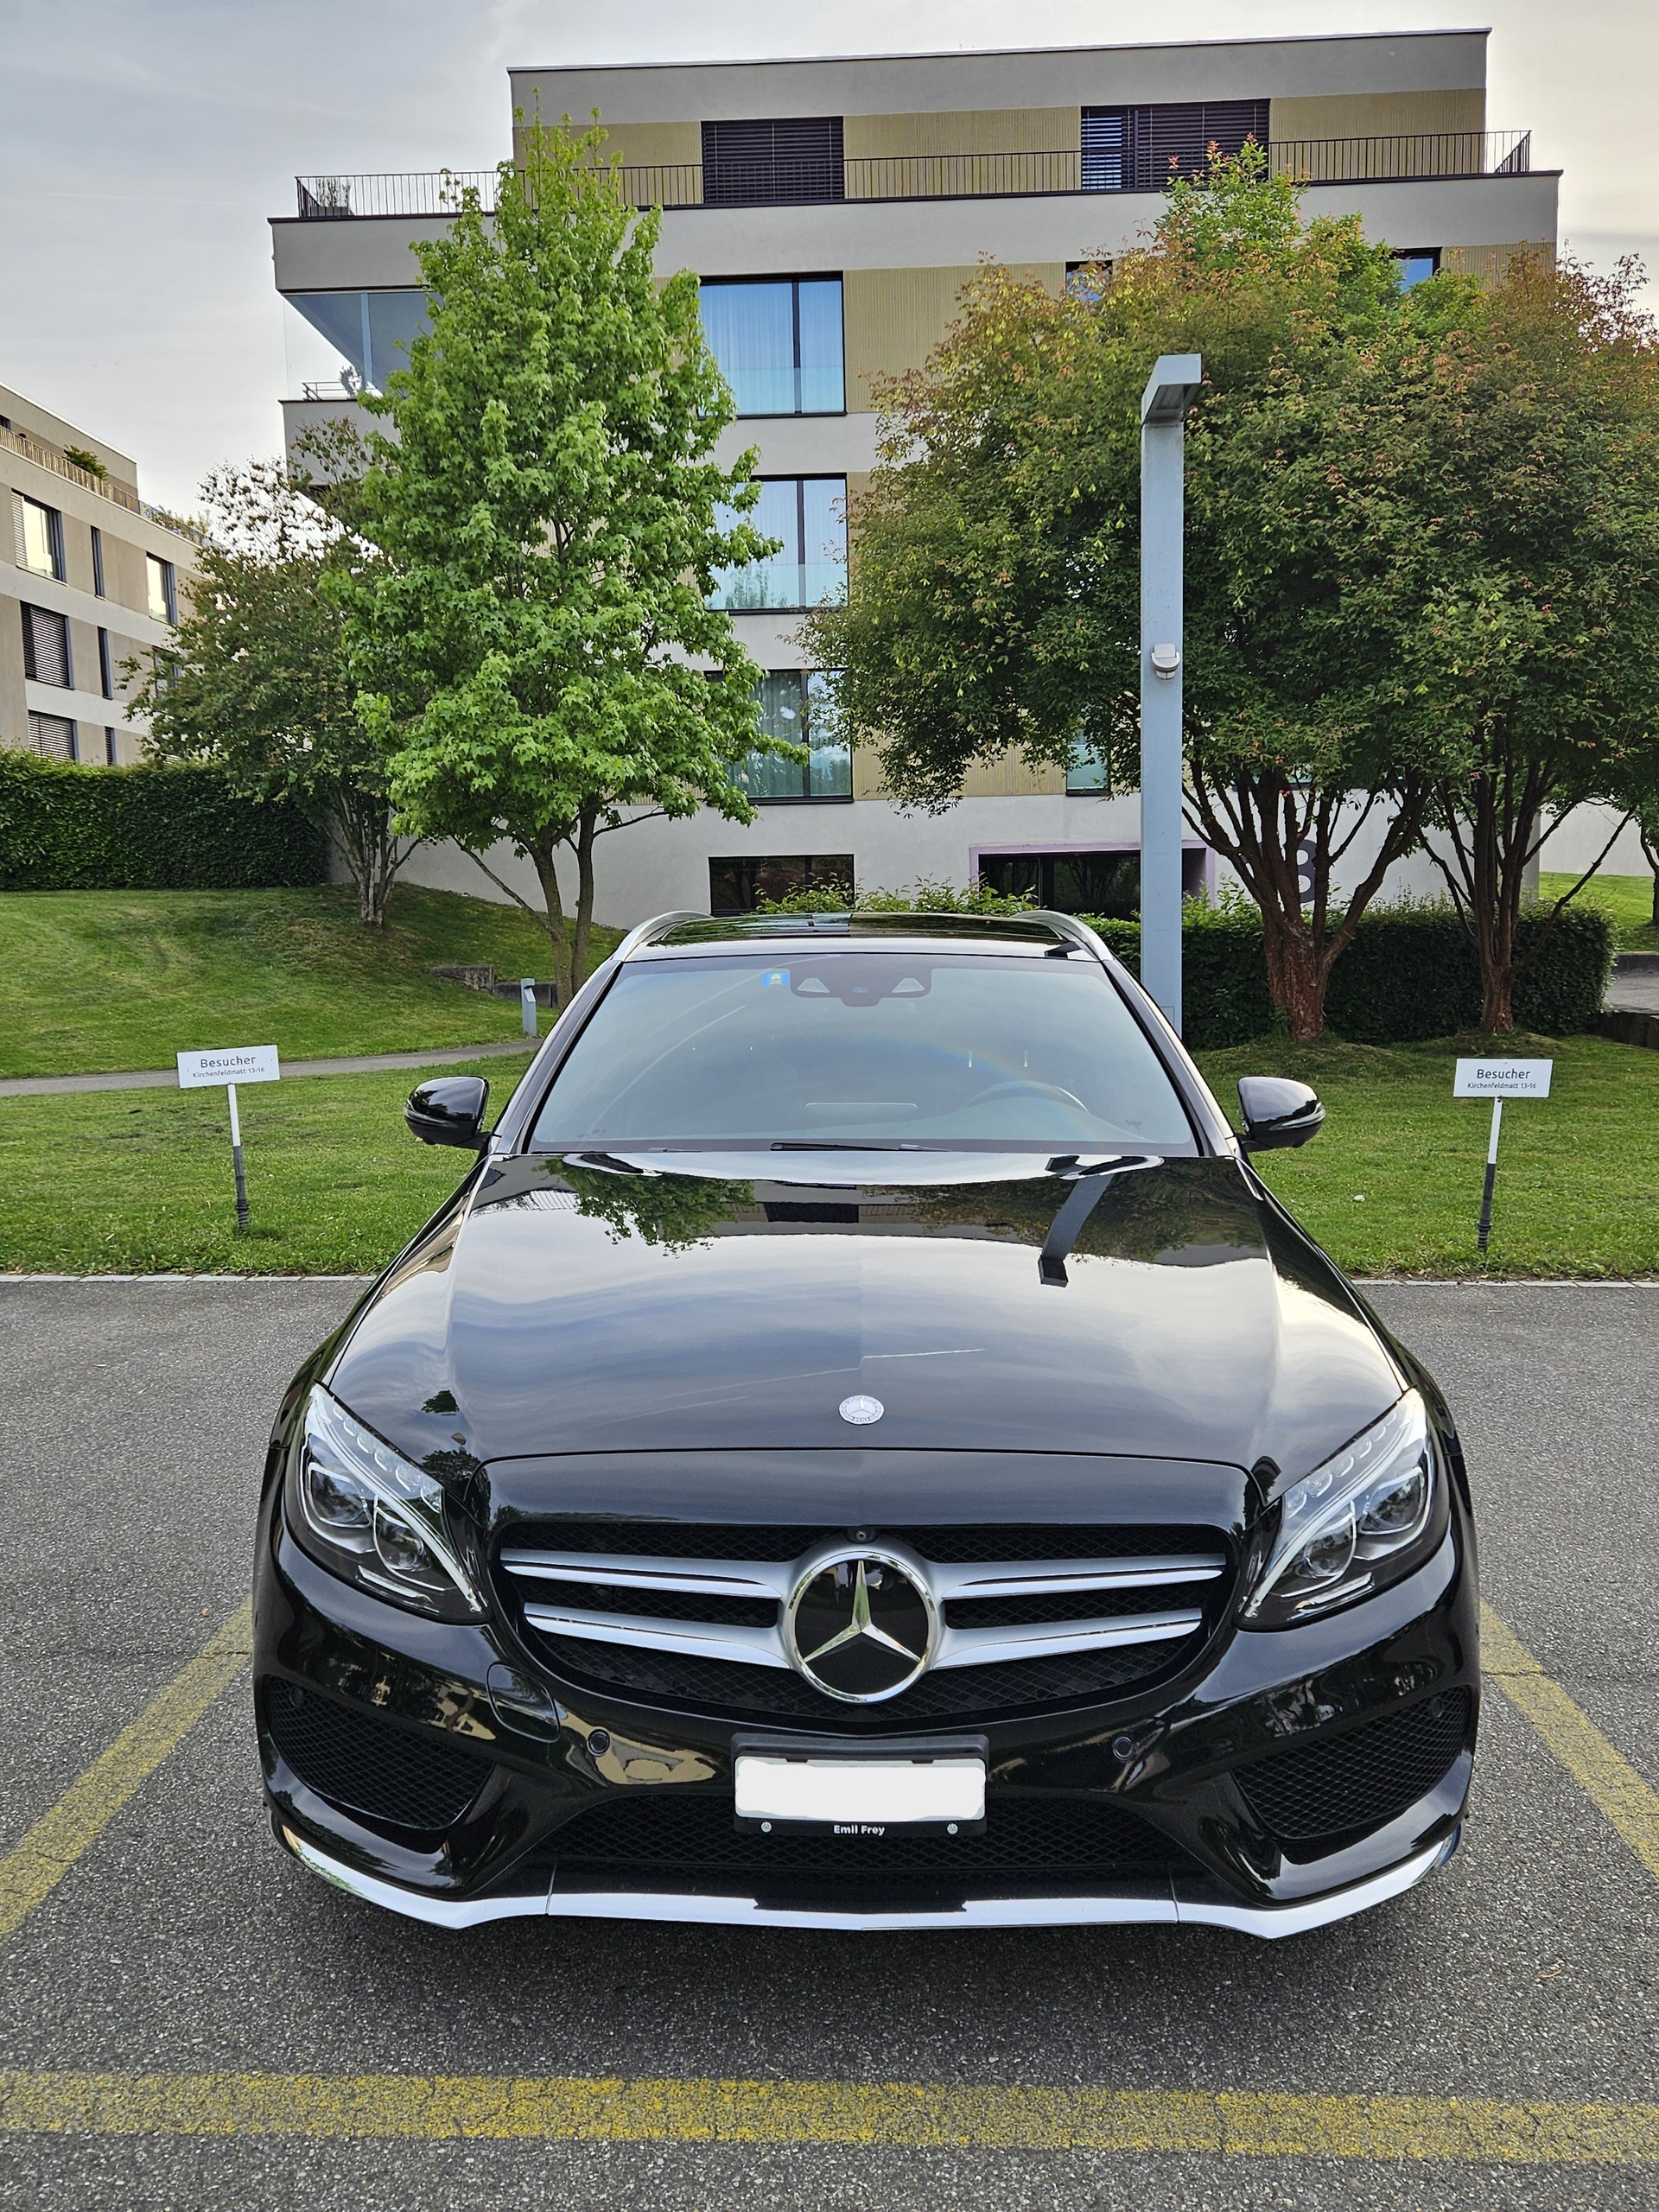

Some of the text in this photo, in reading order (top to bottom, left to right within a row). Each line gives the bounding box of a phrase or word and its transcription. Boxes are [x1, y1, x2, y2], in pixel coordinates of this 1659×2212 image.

[200, 1056, 256, 1068] Besucher
[193, 1069, 246, 1077] Kirchenfeldmatt
[1477, 1068, 1530, 1079] Besucher
[833, 1824, 885, 1836] Emil Frey
